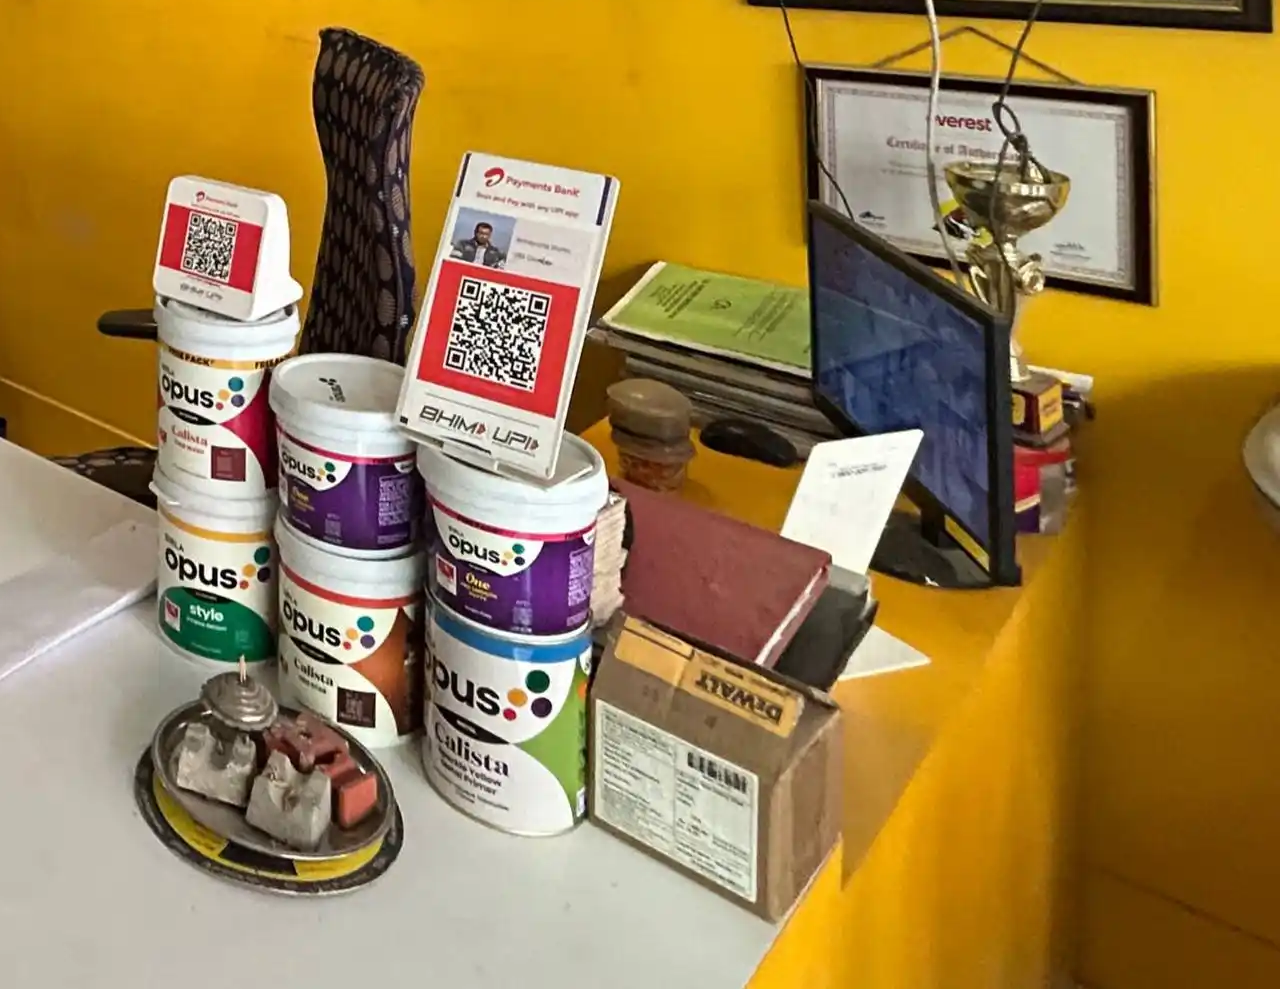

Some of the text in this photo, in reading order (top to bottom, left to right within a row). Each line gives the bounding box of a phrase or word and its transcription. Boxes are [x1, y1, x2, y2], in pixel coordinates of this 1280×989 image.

[506, 175, 580, 197] Payments Bank
[162, 373, 214, 409] opus
[419, 405, 531, 451] BHIM UPI
[282, 451, 317, 480] opus
[449, 534, 500, 564] opus
[165, 547, 238, 589] opus
[465, 572, 491, 590] One
[283, 599, 341, 647] opus
[294, 657, 334, 687] Calista
[434, 721, 509, 778] Calista
